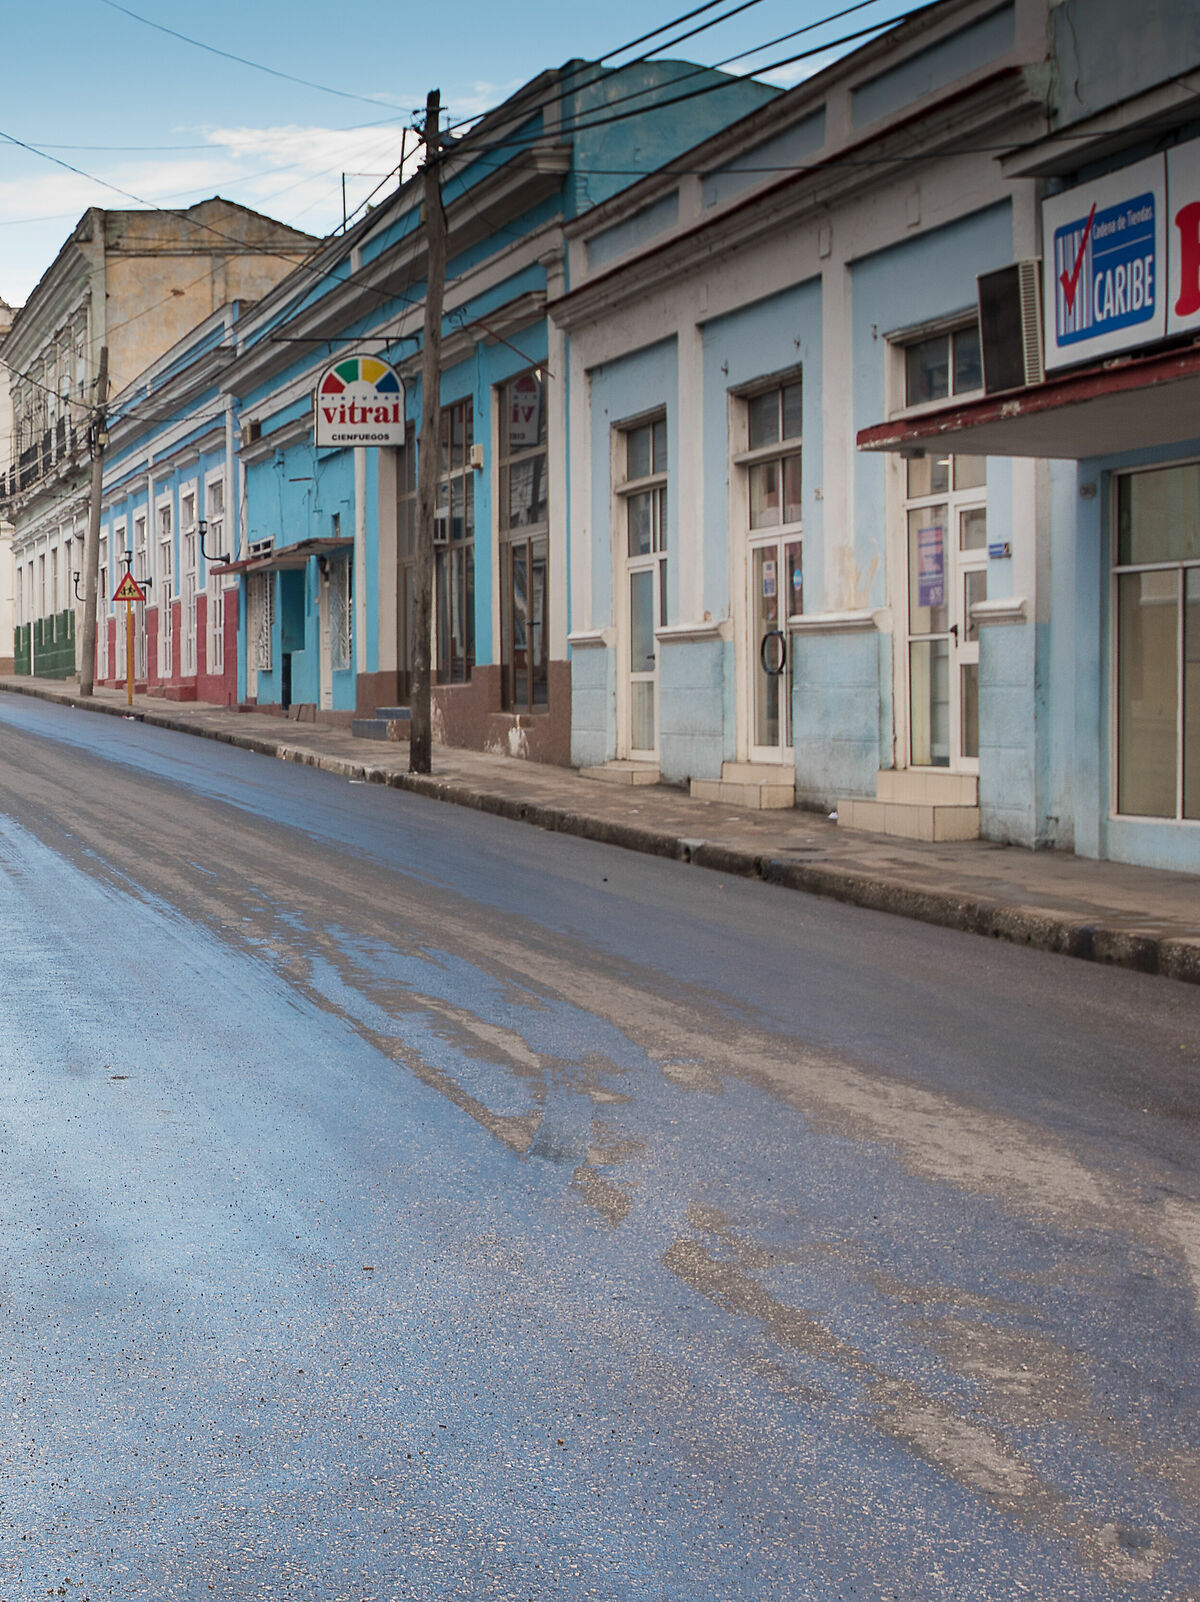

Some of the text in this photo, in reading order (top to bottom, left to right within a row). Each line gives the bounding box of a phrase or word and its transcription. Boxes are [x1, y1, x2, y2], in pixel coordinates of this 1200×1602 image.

[1093, 205, 1153, 240] Cadena de Tiendas
[1094, 254, 1154, 322] CARIBE
[322, 401, 400, 425] vitral
[331, 433, 390, 441] CIENFUEGOS
